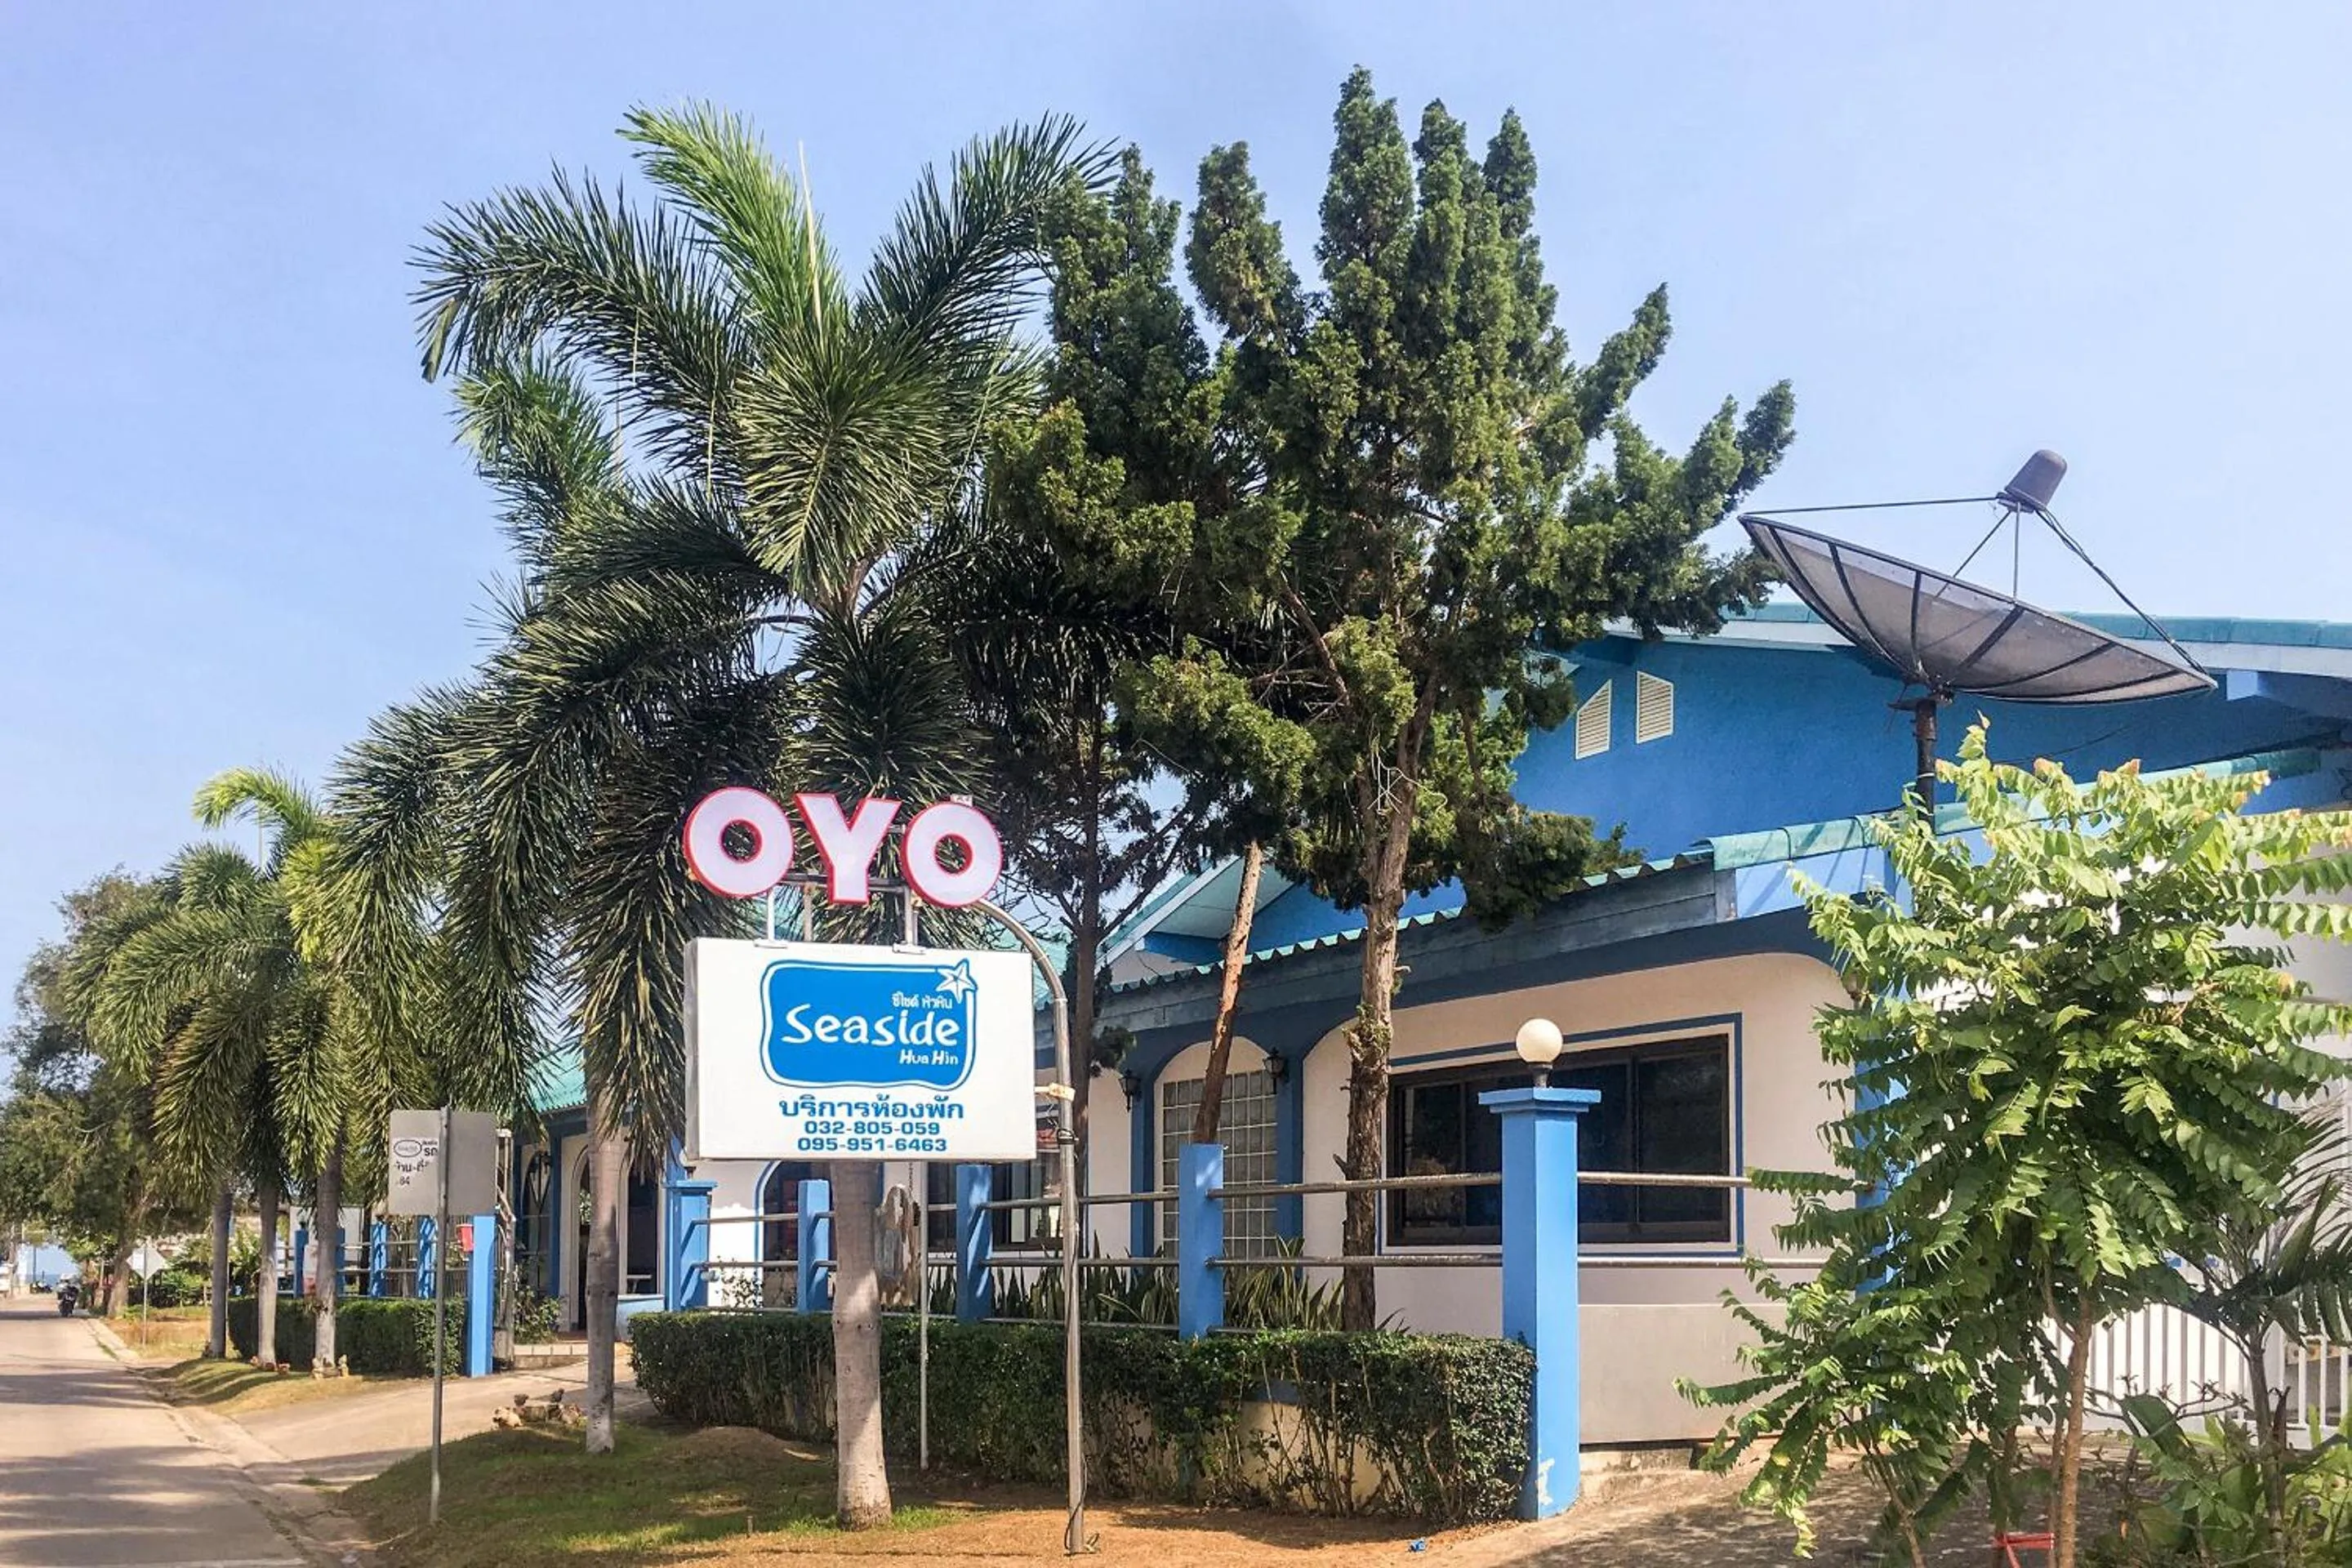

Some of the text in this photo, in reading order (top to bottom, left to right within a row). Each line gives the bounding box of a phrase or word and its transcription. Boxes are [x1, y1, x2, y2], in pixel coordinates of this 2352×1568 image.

[683, 786, 1004, 908] OYO
[922, 995, 953, 1009] หัวหิน
[782, 1003, 960, 1046] Seaside
[899, 1049, 959, 1065] Hua Hin
[779, 1094, 964, 1118] บริการห้องพัก
[804, 1120, 940, 1135] 032-805-059
[797, 1137, 947, 1152] 095-951-6463
